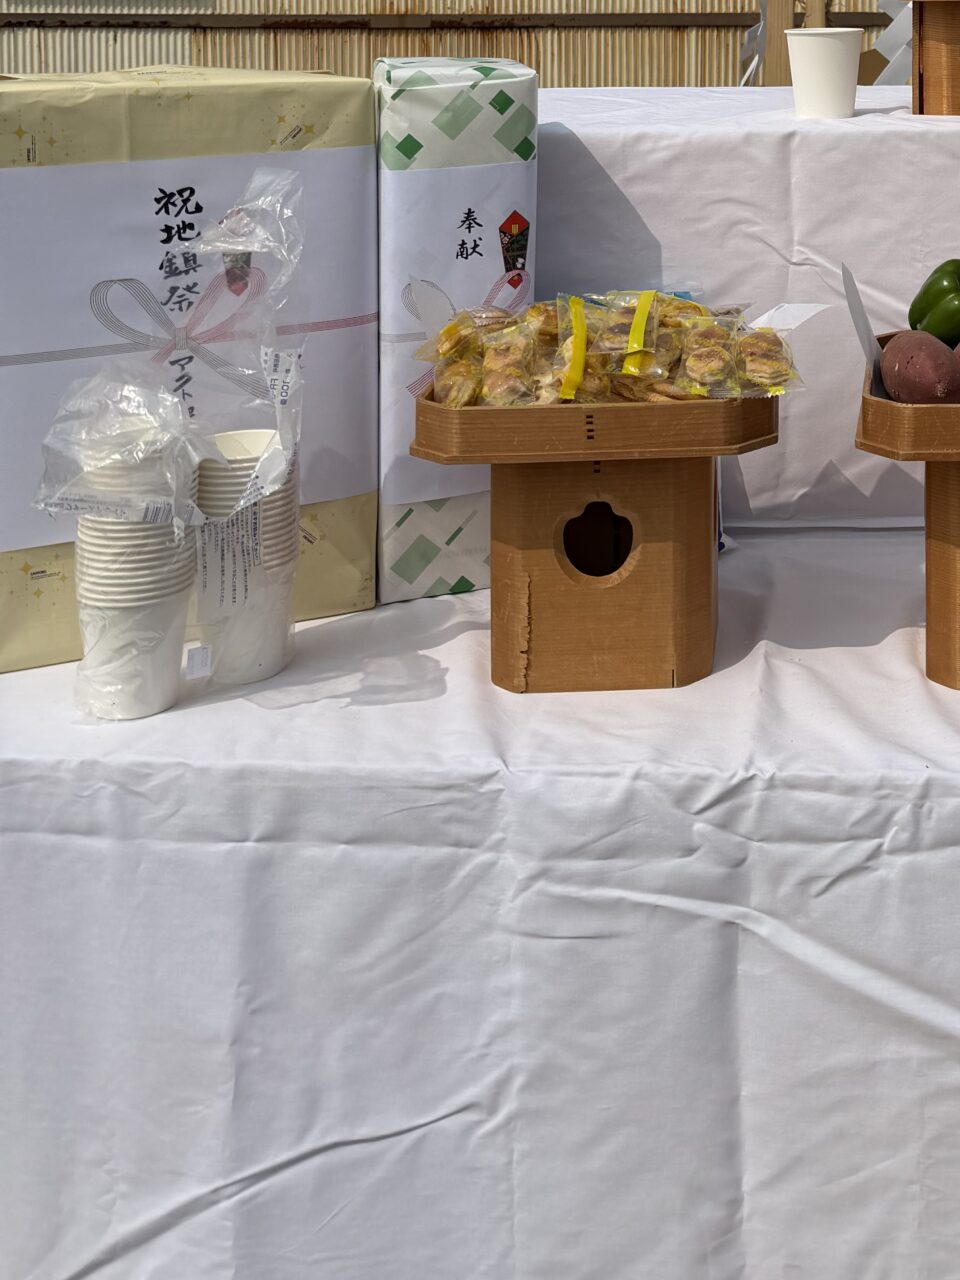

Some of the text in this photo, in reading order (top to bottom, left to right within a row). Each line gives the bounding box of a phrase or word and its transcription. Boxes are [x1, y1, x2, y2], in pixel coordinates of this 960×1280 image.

[154, 186, 203, 312] 祝地鎮祭
[456, 207, 484, 260] 奉献
